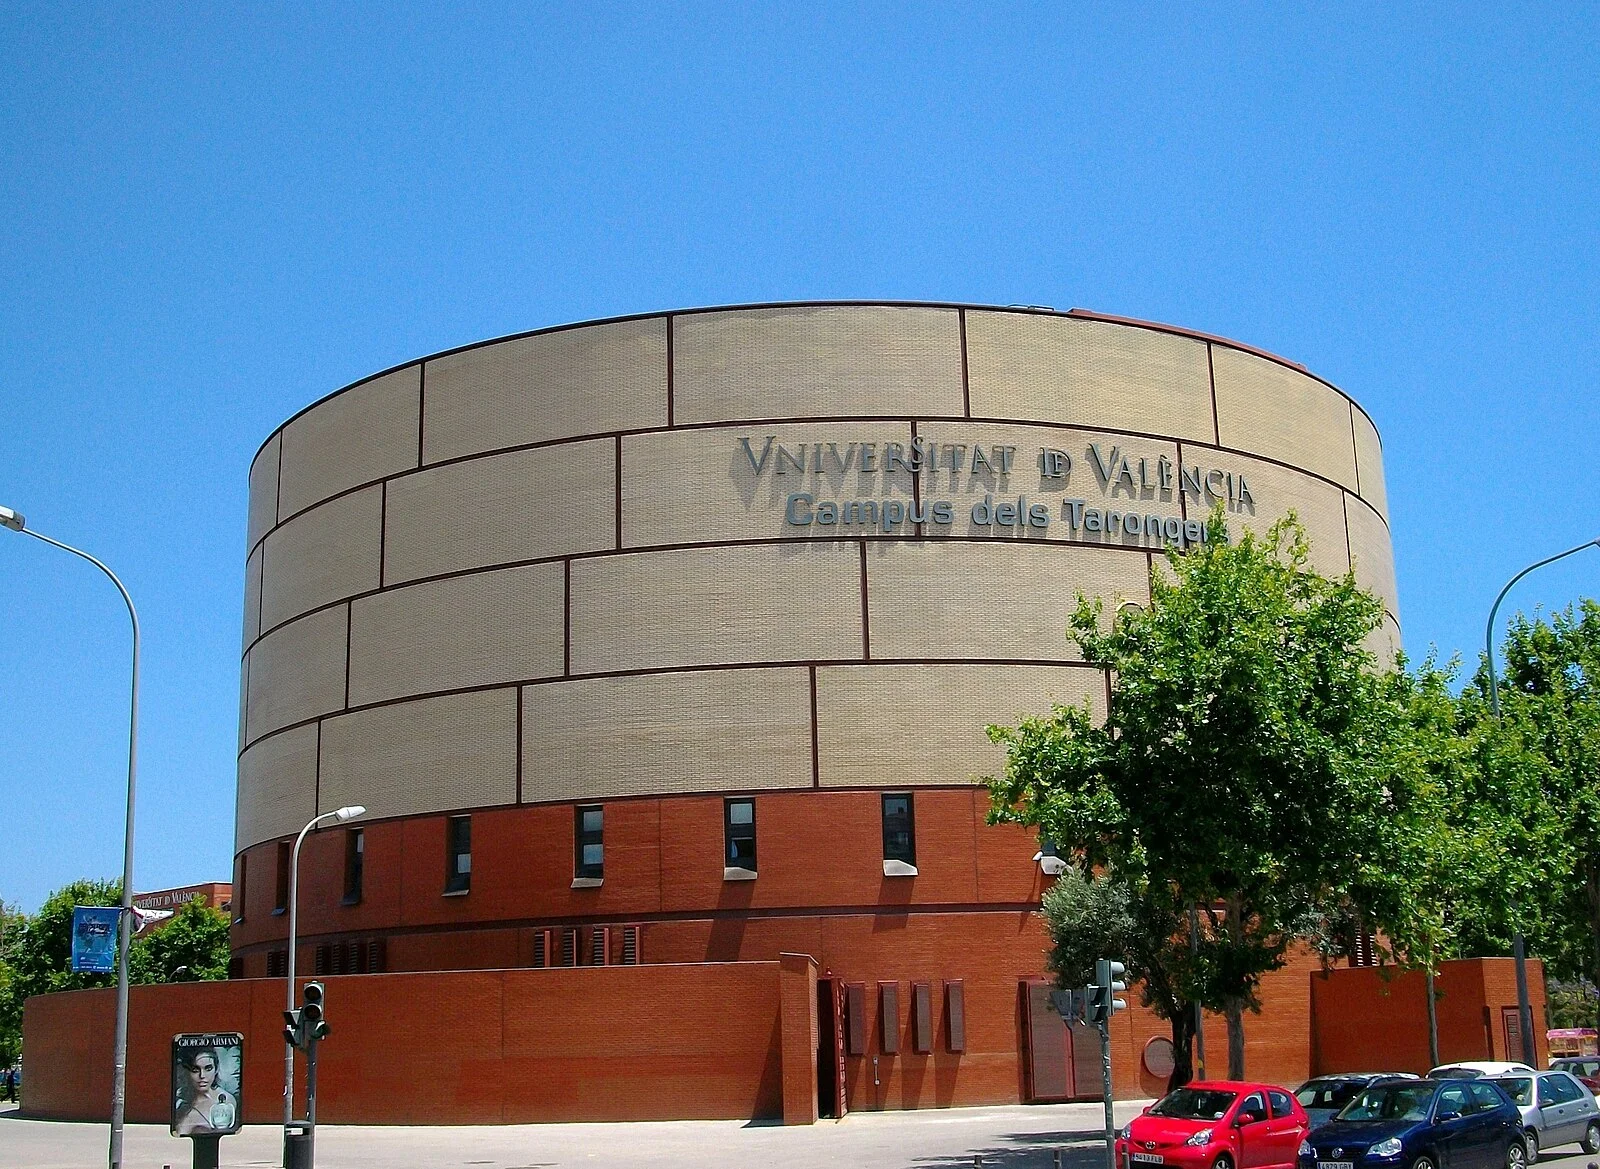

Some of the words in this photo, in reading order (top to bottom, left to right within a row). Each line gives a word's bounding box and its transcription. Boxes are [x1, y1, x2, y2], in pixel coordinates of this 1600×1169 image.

[1088, 442, 1257, 505] VALÈNCIA
[786, 493, 955, 532] Campus
[972, 494, 1050, 528] dels
[178, 1038, 210, 1047] GIORGIO
[211, 1037, 239, 1046] ARMANI
